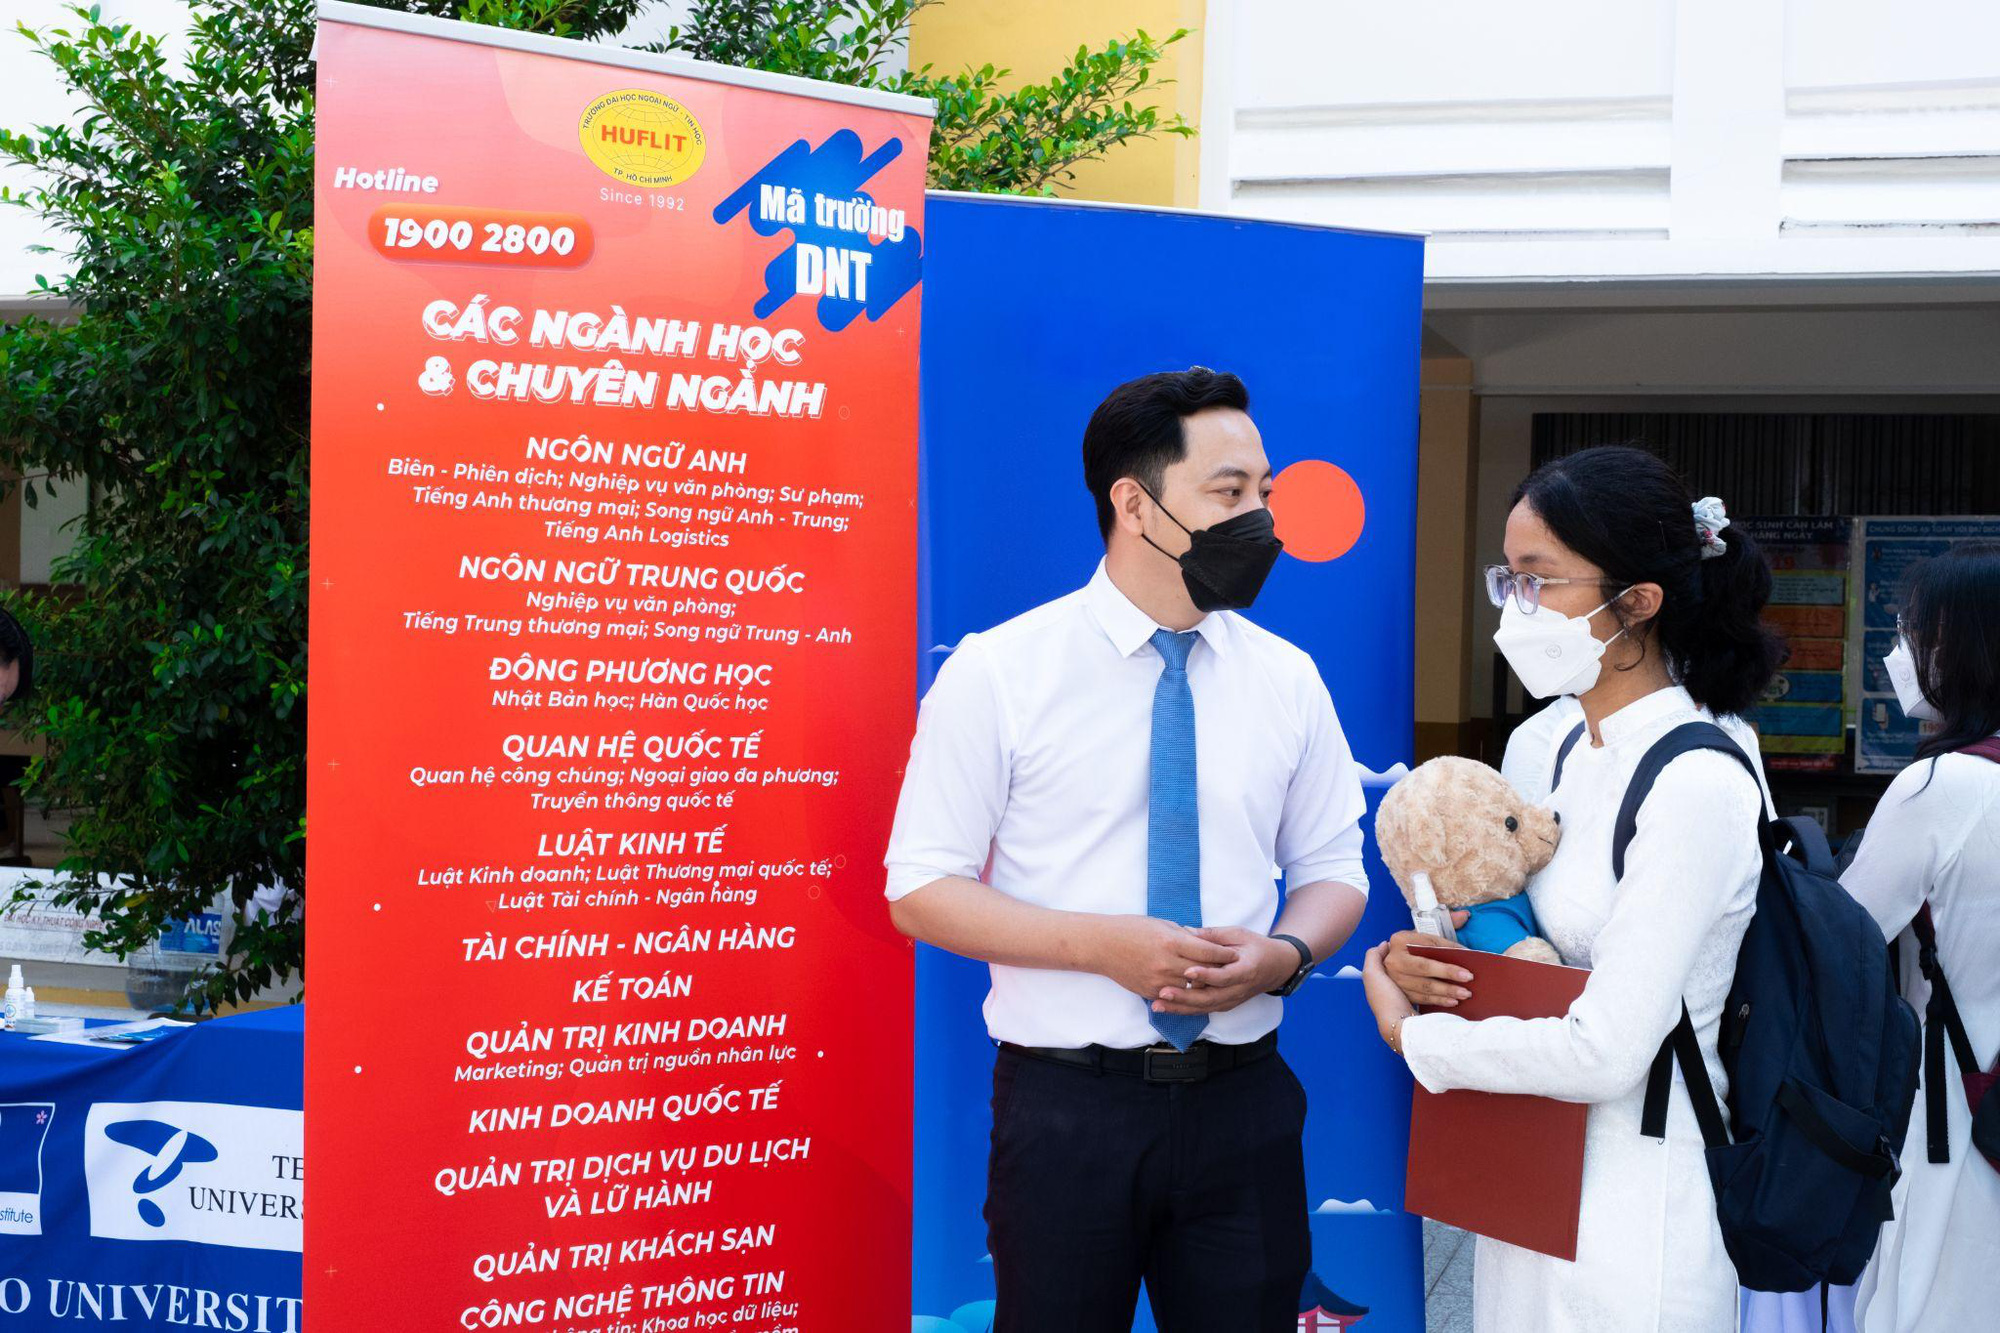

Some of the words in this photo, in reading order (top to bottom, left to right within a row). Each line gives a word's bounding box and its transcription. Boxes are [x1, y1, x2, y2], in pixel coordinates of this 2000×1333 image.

[601, 124, 688, 153] HUFLIT
[333, 165, 439, 195] Hotline
[600, 187, 643, 205] Since
[649, 193, 684, 211] 1992
[760, 184, 806, 224] Mã
[814, 193, 906, 243] trường
[384, 217, 473, 251] 1900
[480, 222, 575, 256] 2800
[796, 242, 872, 302] DNT
[422, 294, 522, 345] CÁC
[530, 304, 701, 357] NGÀNH
[707, 324, 806, 372] HỌC
[418, 355, 455, 396] &
[466, 358, 658, 408] CHUYÊN
[666, 366, 828, 418] NGÀNH
[526, 434, 614, 465] NGÔN
[621, 440, 686, 469] NGỮ
[687, 449, 747, 474] ANH
[387, 457, 435, 477] Biên
[453, 463, 509, 483] Phiên
[514, 467, 564, 489] dịch;
[569, 471, 640, 495] Nghiệp
[645, 479, 668, 497] vụ
[673, 478, 707, 496] văn
[711, 481, 775, 504] phòng;
[779, 485, 805, 502] Sư
[807, 487, 864, 509] phạm;
[413, 485, 468, 510] Tiếng
[471, 491, 513, 509] Anh
[519, 493, 593, 518] thương
[597, 499, 641, 520] mại;
[644, 501, 693, 524] Song
[697, 506, 735, 526] ngữ
[736, 508, 774, 525] Anh
[792, 511, 850, 533] Trung;
[459, 552, 547, 582] NGÔN
[553, 556, 622, 586] NGỮ
[626, 563, 719, 590] TRUNG
[725, 563, 806, 596] QUỐC
[403, 610, 459, 635] Tiếng
[464, 614, 523, 637] Trung
[528, 616, 601, 640] thương
[606, 619, 649, 640] mại;
[653, 621, 700, 642] Song
[704, 623, 742, 644] ngữ
[745, 624, 800, 646] Trung
[815, 627, 852, 644] Anh
[488, 652, 579, 682] ĐÔNG
[585, 657, 708, 685] PHƯƠNG
[713, 663, 773, 691] HỌC
[491, 689, 543, 711] Nhật
[547, 688, 588, 708] Bản
[593, 691, 635, 712] học;
[639, 692, 678, 709] Hàn
[683, 691, 730, 713] Quốc
[734, 694, 769, 714] học
[502, 734, 590, 763] QUAN
[597, 730, 637, 764] HỆ
[643, 728, 723, 763] QUỐC
[729, 729, 764, 759] TẾ
[409, 766, 465, 787] Quan
[470, 766, 496, 787] hệ
[500, 766, 551, 788] công
[556, 766, 625, 787] chúng;
[629, 766, 686, 787] Ngoại
[689, 766, 730, 787] giao
[734, 767, 758, 783] đa
[762, 767, 839, 787] phương;
[530, 790, 599, 813] Truyền
[604, 791, 662, 813] thông
[666, 789, 712, 812] quốc
[716, 790, 735, 808] tế
[537, 827, 614, 862] LUẬT
[618, 832, 687, 855] KINH
[694, 823, 728, 854] TẾ
[417, 867, 464, 889] Luật
[468, 865, 515, 884] Kinh
[520, 864, 592, 884] doanh;
[596, 863, 640, 884] Luật
[645, 863, 714, 882] Thương
[719, 860, 755, 878] mại
[758, 860, 805, 880] quốc
[809, 860, 832, 878] tế;
[462, 931, 508, 962] TÀI
[515, 929, 609, 959] CHÍNH
[633, 924, 712, 955] NGÂN
[718, 922, 796, 951] HÀNG
[572, 970, 614, 1003] KẾ
[618, 970, 693, 1001] TOÁN
[466, 1020, 554, 1060] QUẢN
[562, 1024, 606, 1054] TRỊ
[613, 1020, 681, 1047] KINH
[687, 1014, 787, 1041] DOANH
[454, 1059, 564, 1082] Marketing;
[569, 1054, 622, 1078] Quản
[628, 1052, 649, 1074] trị
[653, 1047, 712, 1072] nguồn
[716, 1045, 764, 1064] nhân
[769, 1044, 797, 1064] lực
[468, 1105, 543, 1134] KINH
[550, 1097, 656, 1128] DOANH
[662, 1083, 742, 1122] QUỐC
[748, 1079, 783, 1111] TẾ
[434, 1155, 522, 1196] QUẢN
[530, 1158, 576, 1187] TRỊ
[582, 1151, 652, 1184] DỊCH
[660, 1147, 697, 1176] VỤ
[703, 1142, 743, 1168] DU
[749, 1137, 811, 1168] LỊCH
[188, 1186, 304, 1220] UNIVER
[544, 1188, 582, 1219] VÀ
[590, 1183, 630, 1215] LỮ
[633, 1179, 713, 1210] HÀNH
[473, 1242, 561, 1282] QUẢN
[569, 1242, 612, 1271] TRỊ
[619, 1229, 715, 1263] KHÁCH
[720, 1224, 775, 1255] SẠN
[460, 1298, 546, 1331] CÔNG
[553, 1283, 635, 1320] NGHỆ
[641, 1278, 735, 1310] THÔNG
[742, 1270, 785, 1296] TIN
[641, 1315, 690, 1333] Khoa
[694, 1311, 728, 1330] học
[732, 1304, 758, 1323] dữ
[760, 1300, 799, 1321] liệu;
